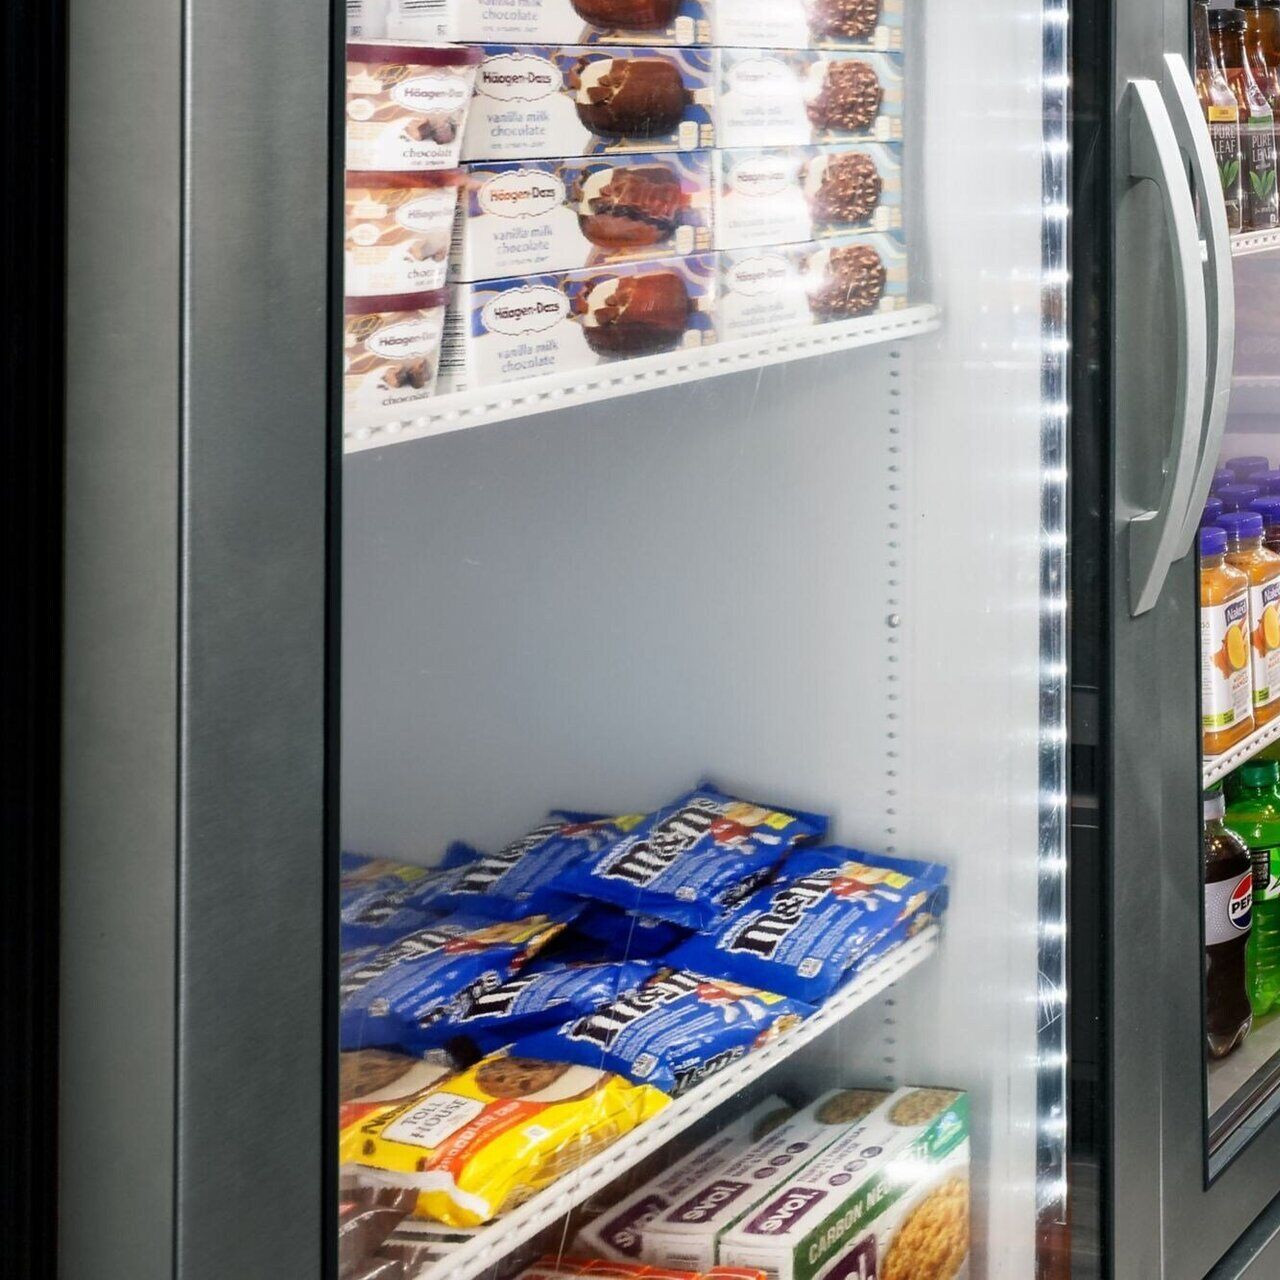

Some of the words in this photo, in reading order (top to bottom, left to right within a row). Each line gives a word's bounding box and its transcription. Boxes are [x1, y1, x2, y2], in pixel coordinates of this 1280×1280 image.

[482, 9, 538, 21] chocolate
[1213, 125, 1236, 138] PURE
[1215, 140, 1235, 153] LEAF
[1252, 132, 1272, 148] PURE
